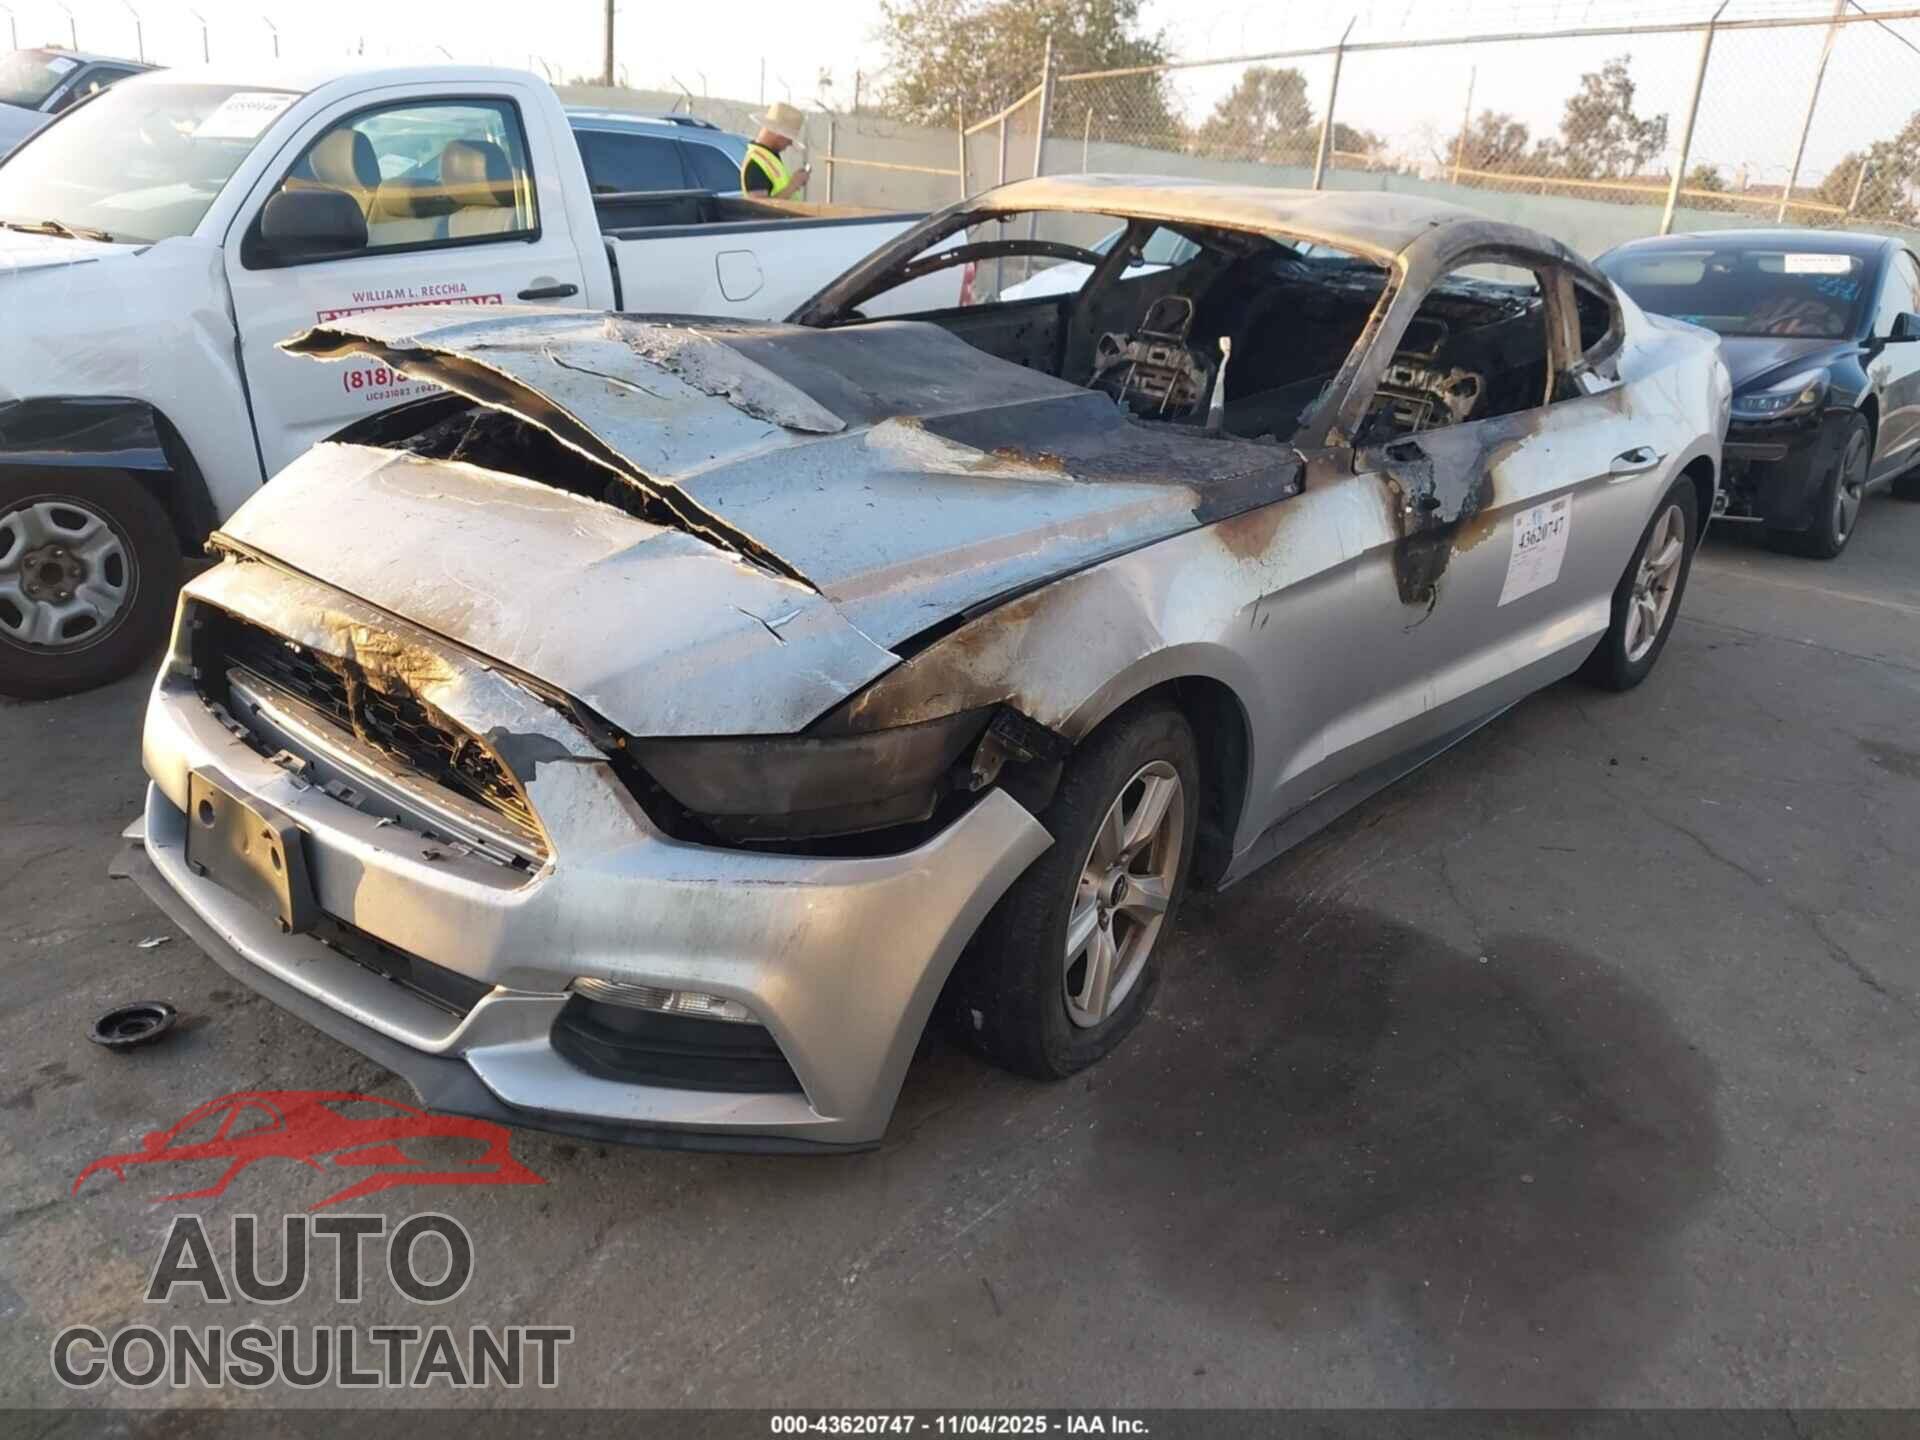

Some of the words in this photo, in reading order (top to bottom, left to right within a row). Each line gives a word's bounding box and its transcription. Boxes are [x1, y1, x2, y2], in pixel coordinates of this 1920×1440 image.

[352, 287, 406, 303] WILLIAM
[421, 283, 467, 297] RECCHIA
[1518, 516, 1565, 549] 43620747
